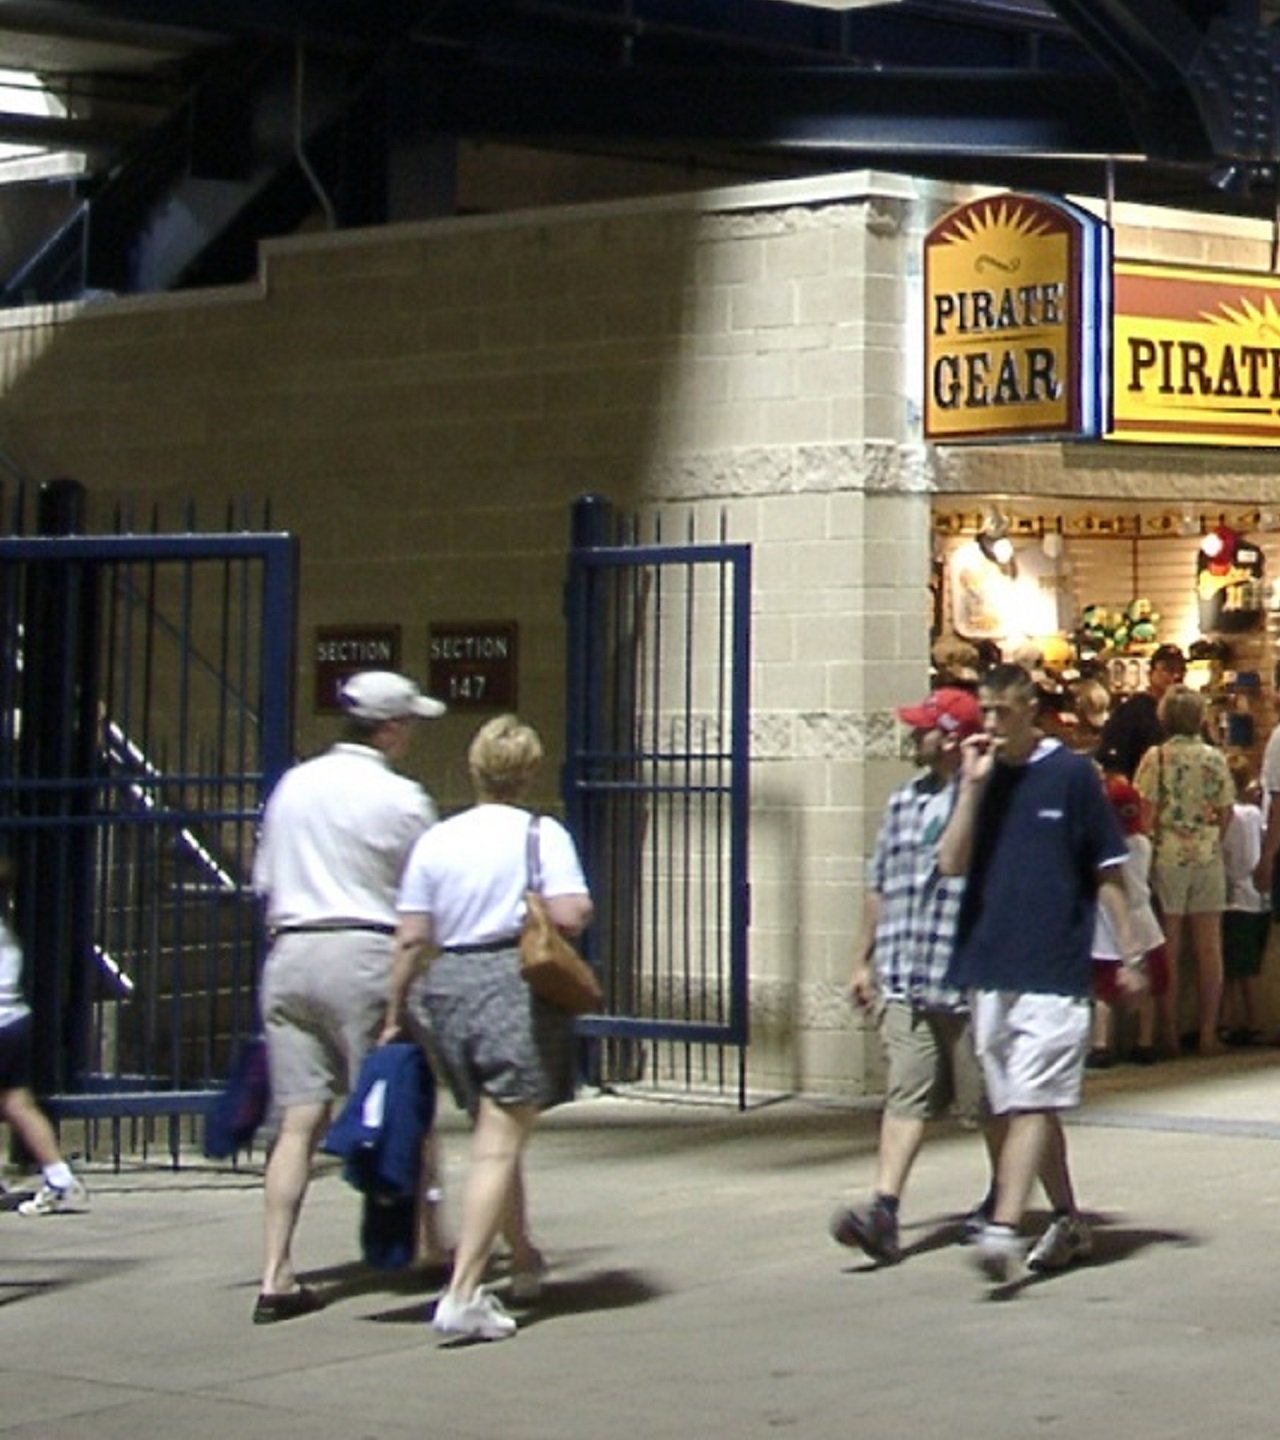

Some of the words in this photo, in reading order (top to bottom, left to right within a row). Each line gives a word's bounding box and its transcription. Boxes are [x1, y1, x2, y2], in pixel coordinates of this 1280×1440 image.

[934, 281, 1065, 335] PIRATE
[932, 347, 1063, 410] GEAR
[317, 638, 392, 661] SECTION
[430, 635, 508, 659] SECTION
[449, 674, 487, 699] 147
